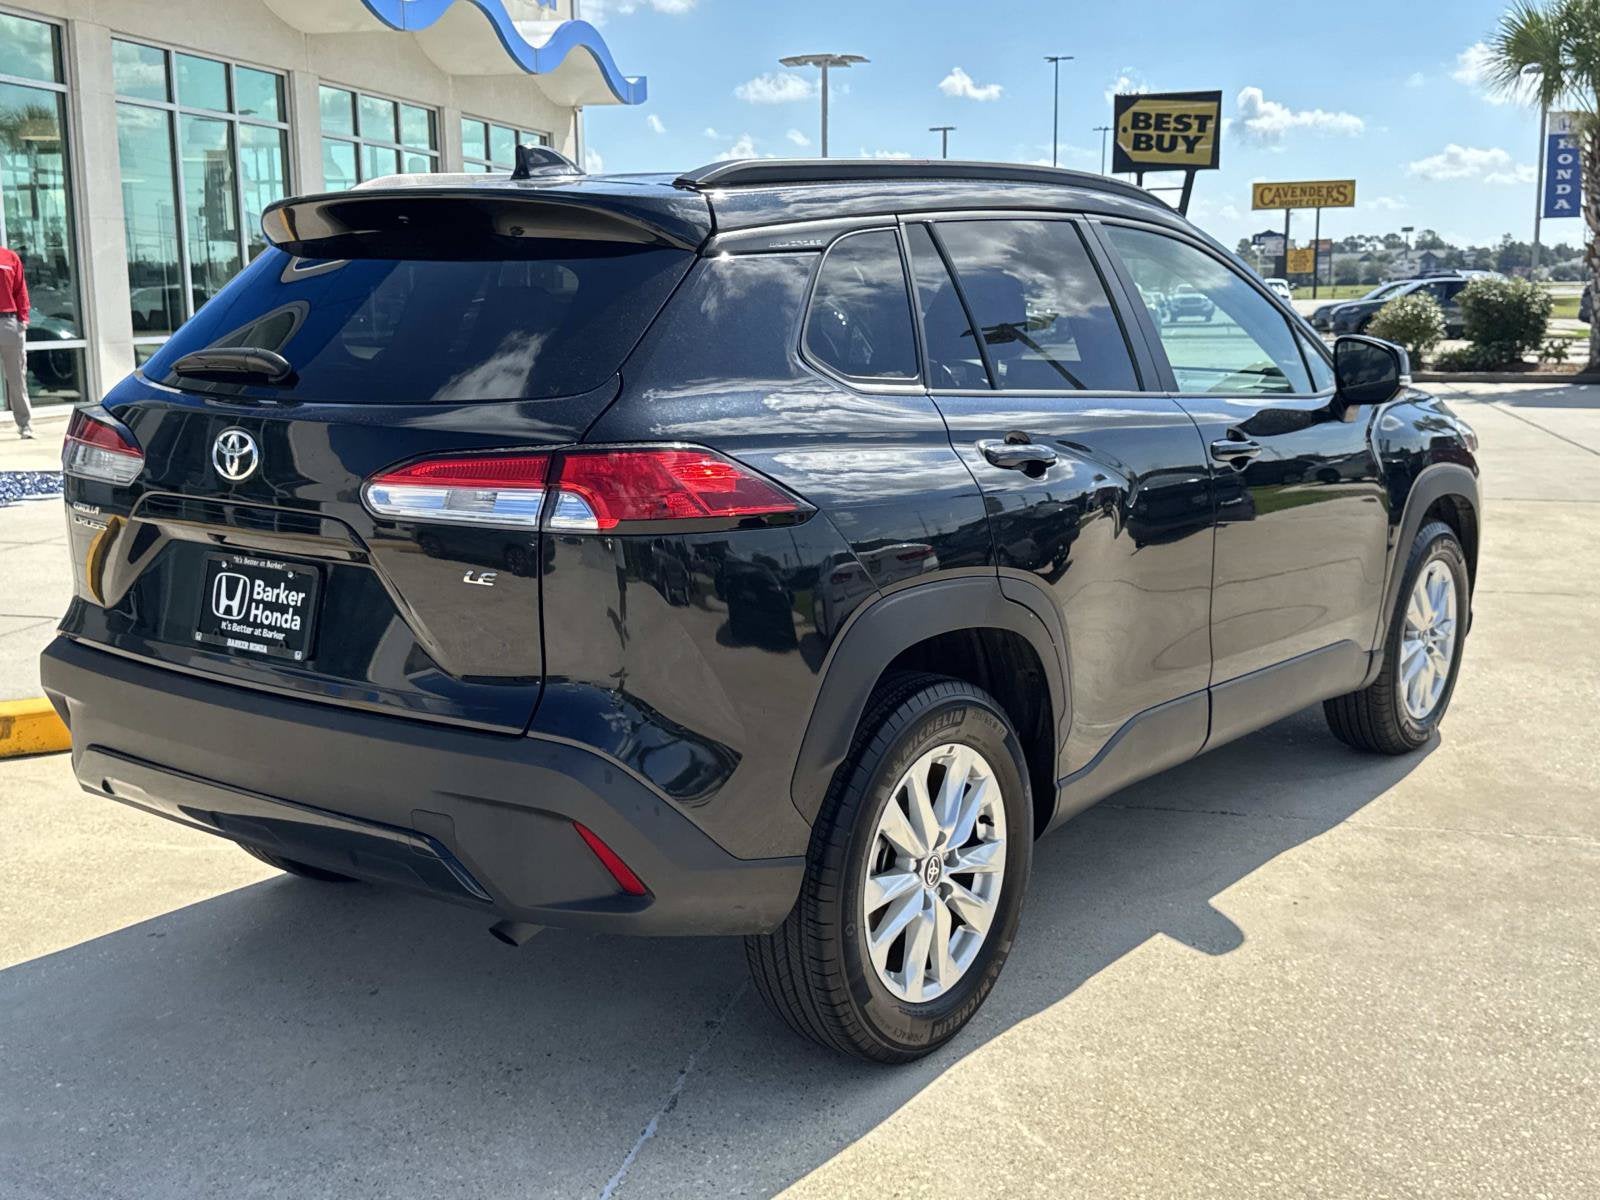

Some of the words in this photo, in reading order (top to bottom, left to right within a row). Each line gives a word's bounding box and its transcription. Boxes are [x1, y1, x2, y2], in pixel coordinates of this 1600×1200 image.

[1131, 112, 1213, 133] BEST
[1132, 133, 1204, 154] BUY
[1553, 139, 1573, 210] HONDA
[1260, 184, 1348, 206] CAVENDER'S
[463, 570, 498, 586] LE
[253, 579, 306, 607] Barker
[249, 602, 301, 631] Honda
[221, 620, 232, 631] It's
[232, 622, 254, 635] Better
[254, 627, 262, 636] at
[262, 628, 285, 641] Barker
